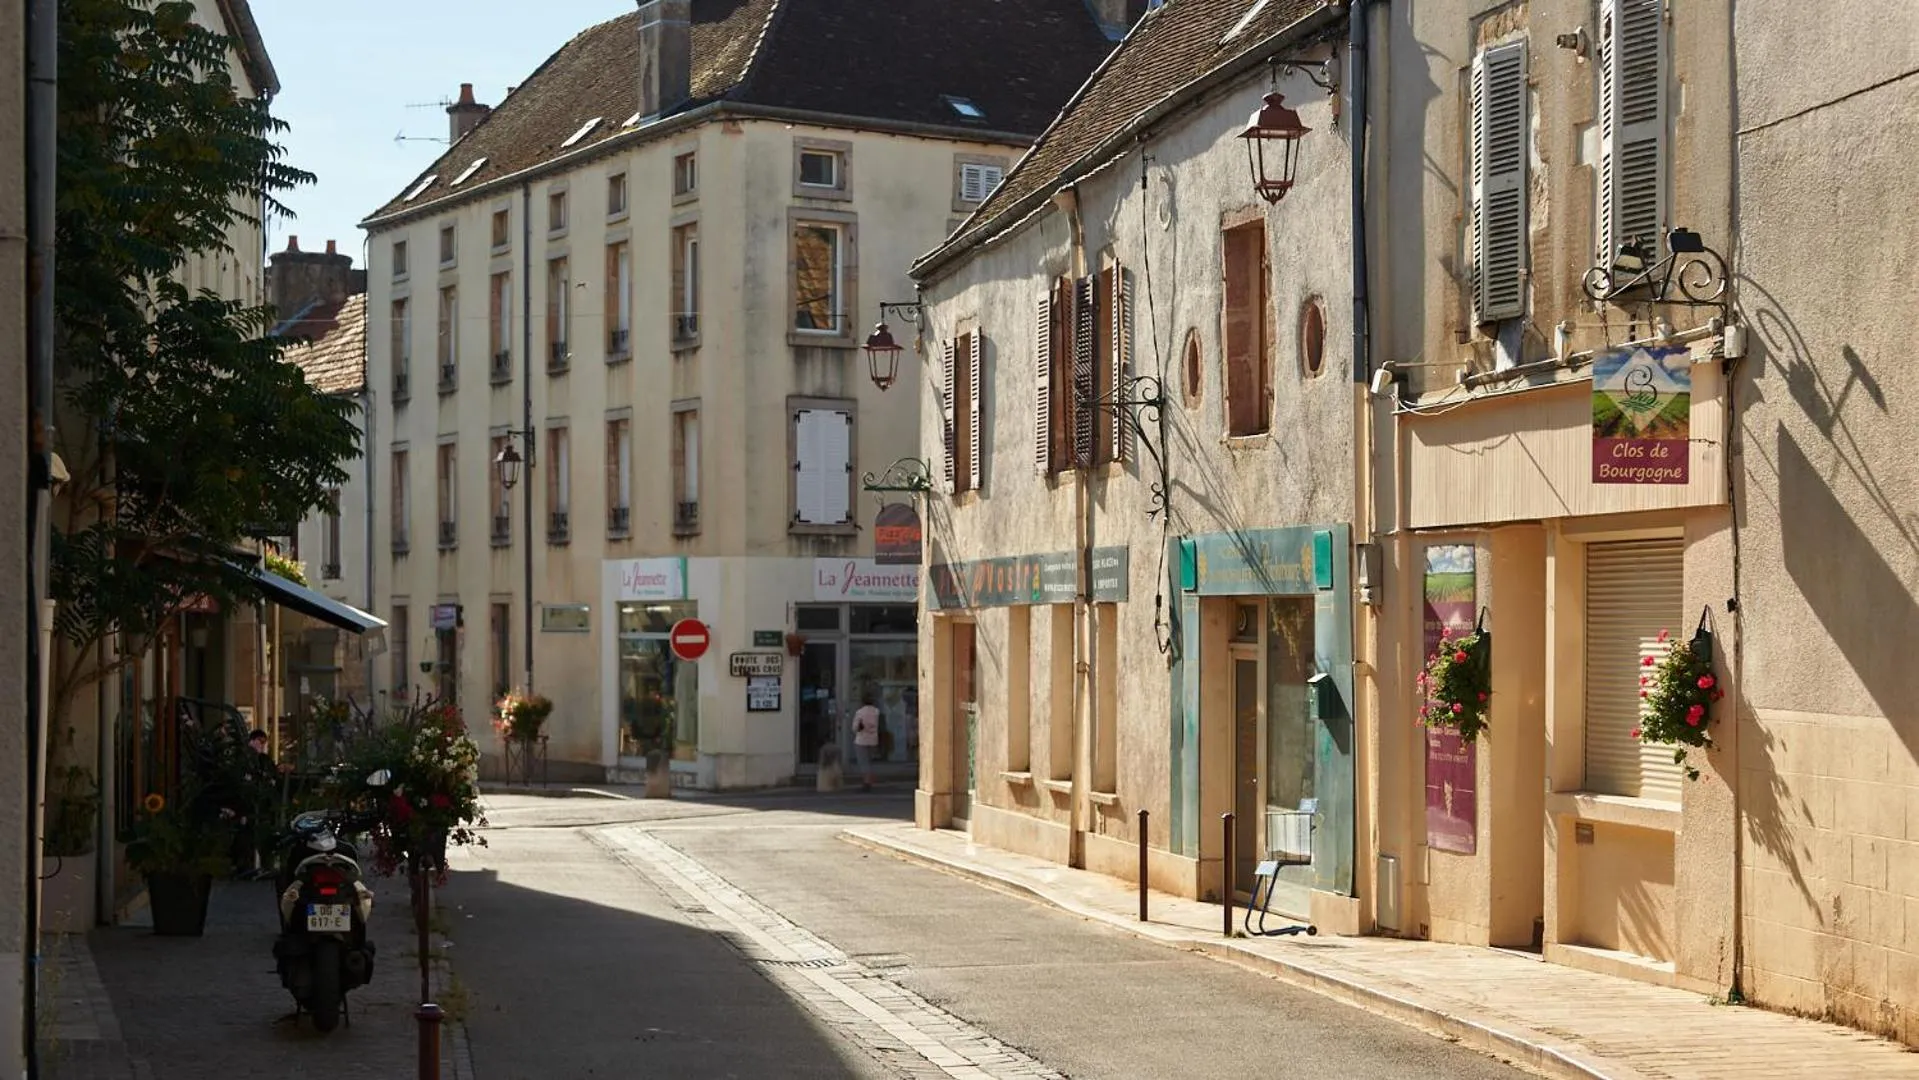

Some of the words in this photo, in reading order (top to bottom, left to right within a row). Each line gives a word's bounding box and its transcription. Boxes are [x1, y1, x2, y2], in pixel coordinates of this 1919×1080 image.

[1612, 442, 1644, 458] Clos
[1650, 442, 1669, 458] de
[1599, 463, 1682, 482] Bourgogne
[818, 569, 836, 586] La
[841, 561, 919, 594] Jeannette
[735, 656, 758, 664] ROUTE
